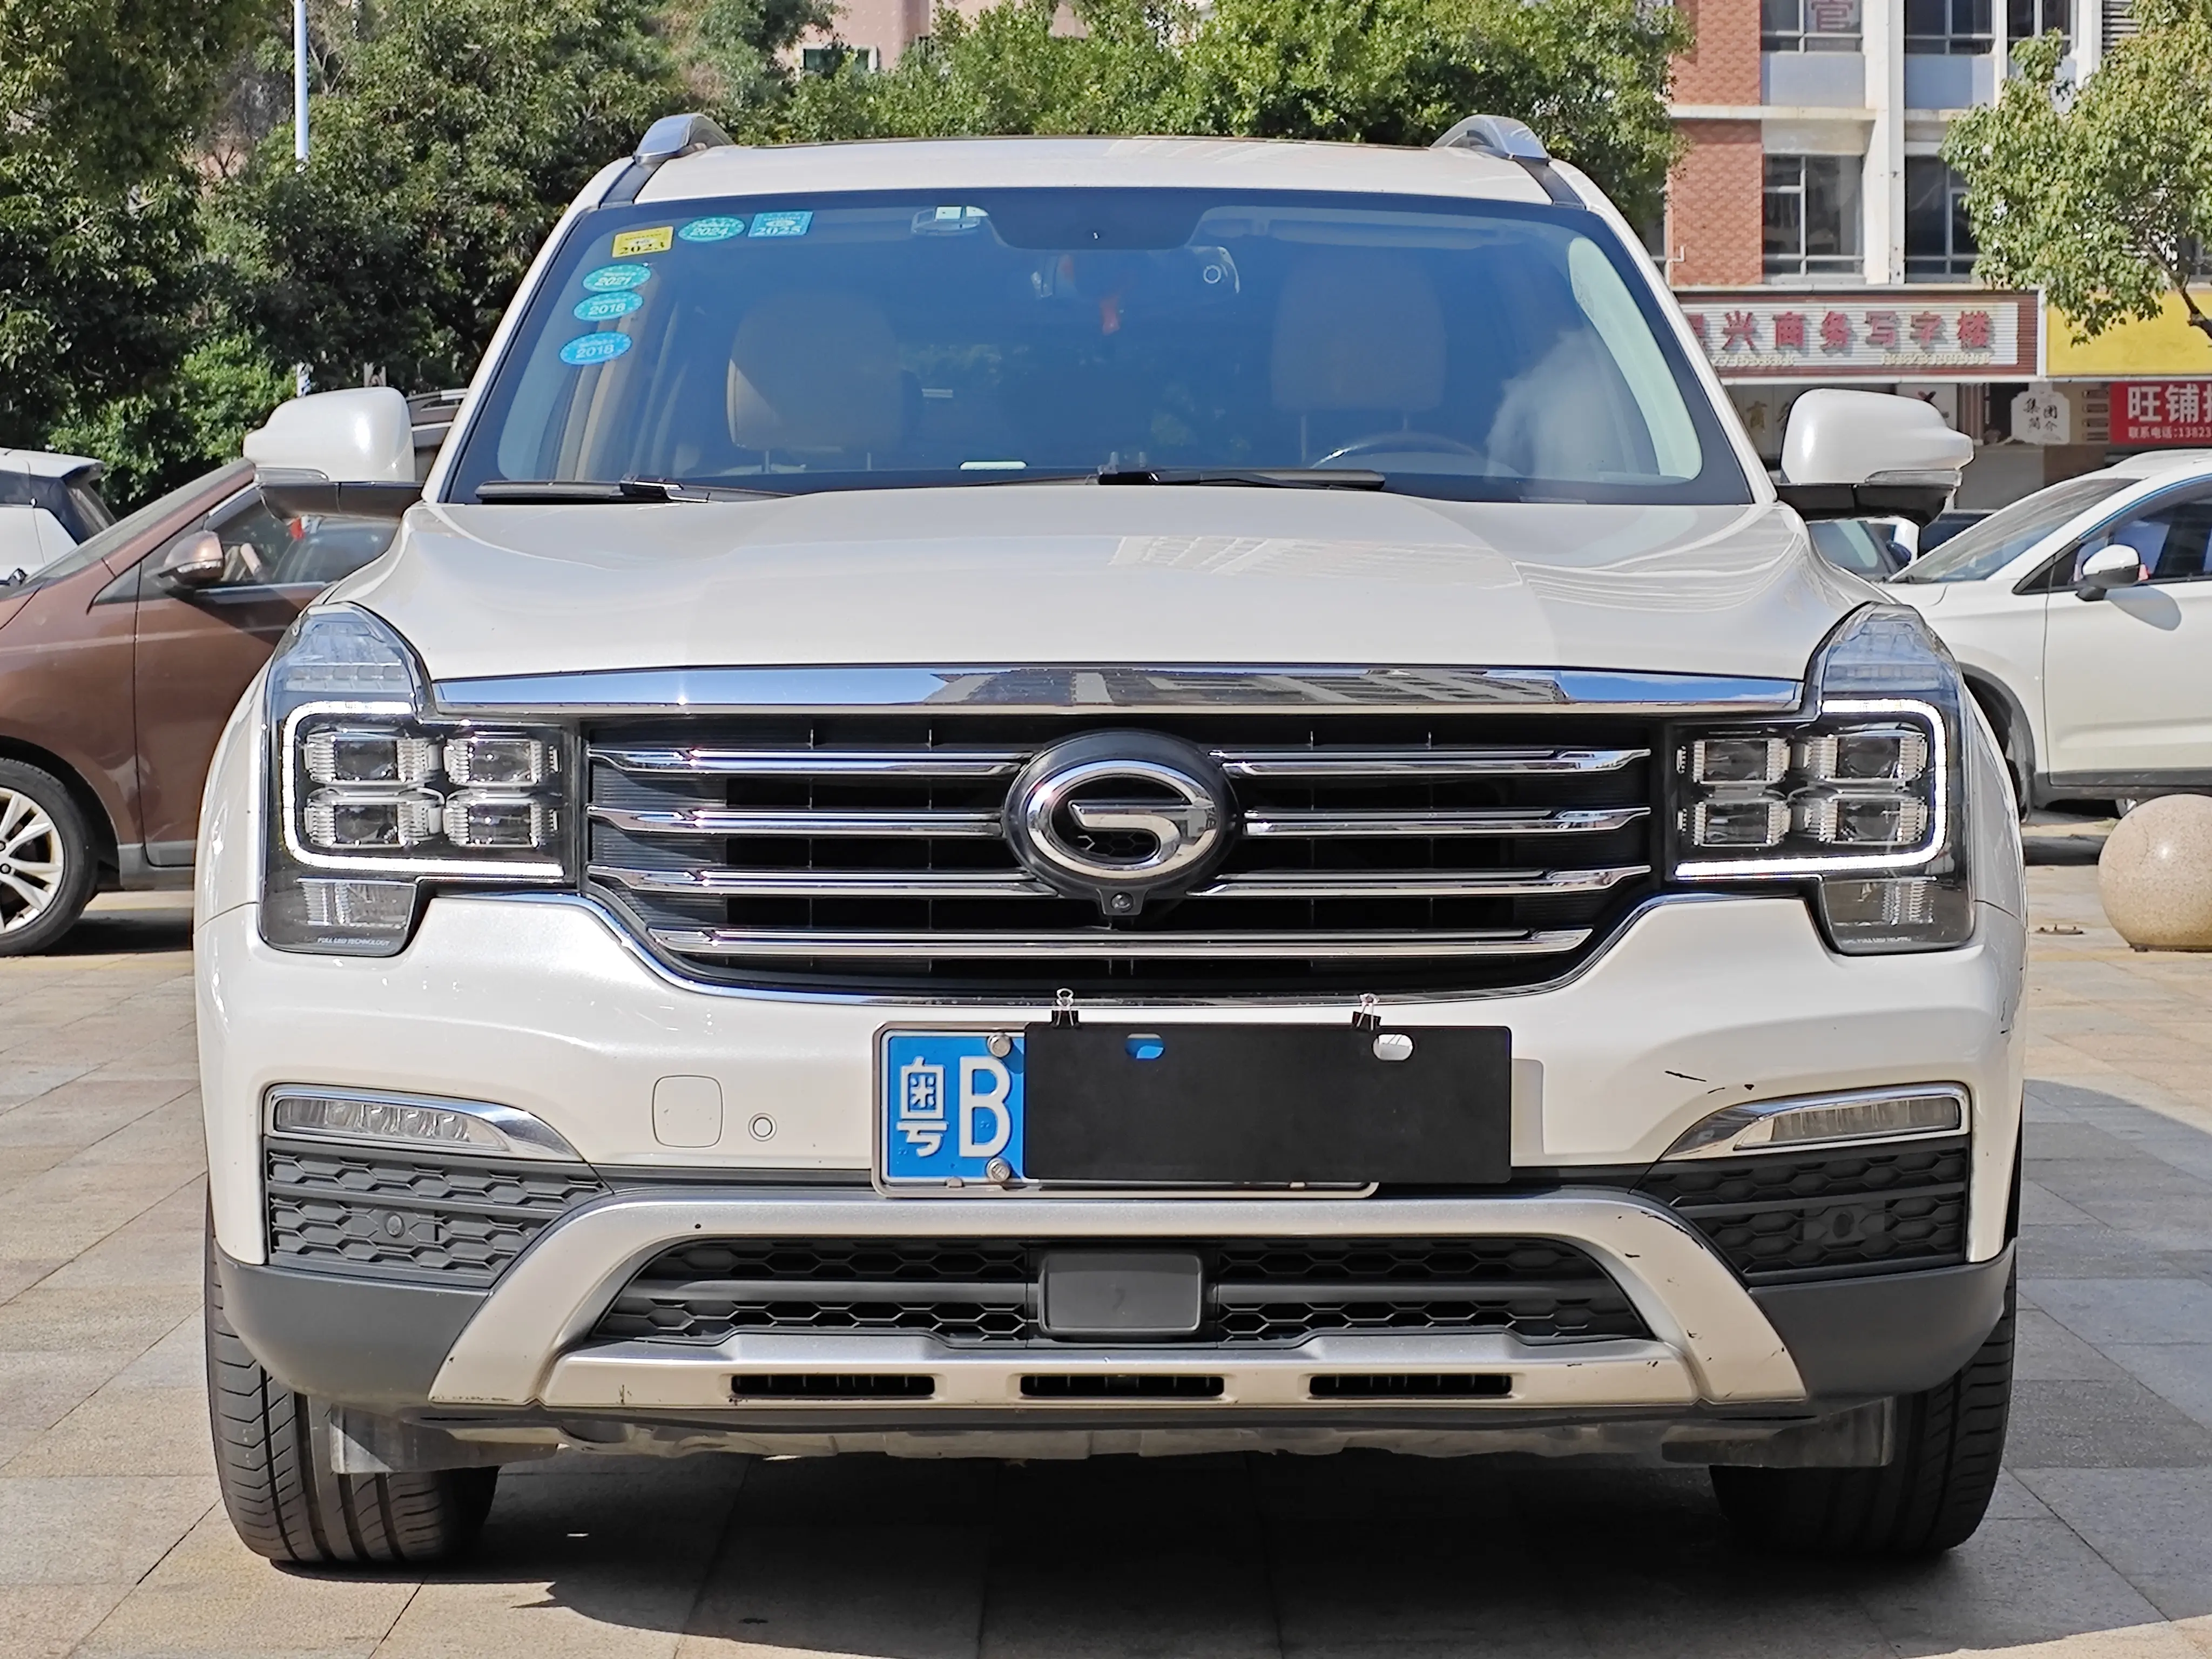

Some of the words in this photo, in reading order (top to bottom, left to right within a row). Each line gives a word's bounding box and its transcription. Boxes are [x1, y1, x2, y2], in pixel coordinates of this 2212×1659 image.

[689, 227, 729, 238] 2024
[588, 302, 626, 315] 2018
[575, 344, 615, 359] 2018
